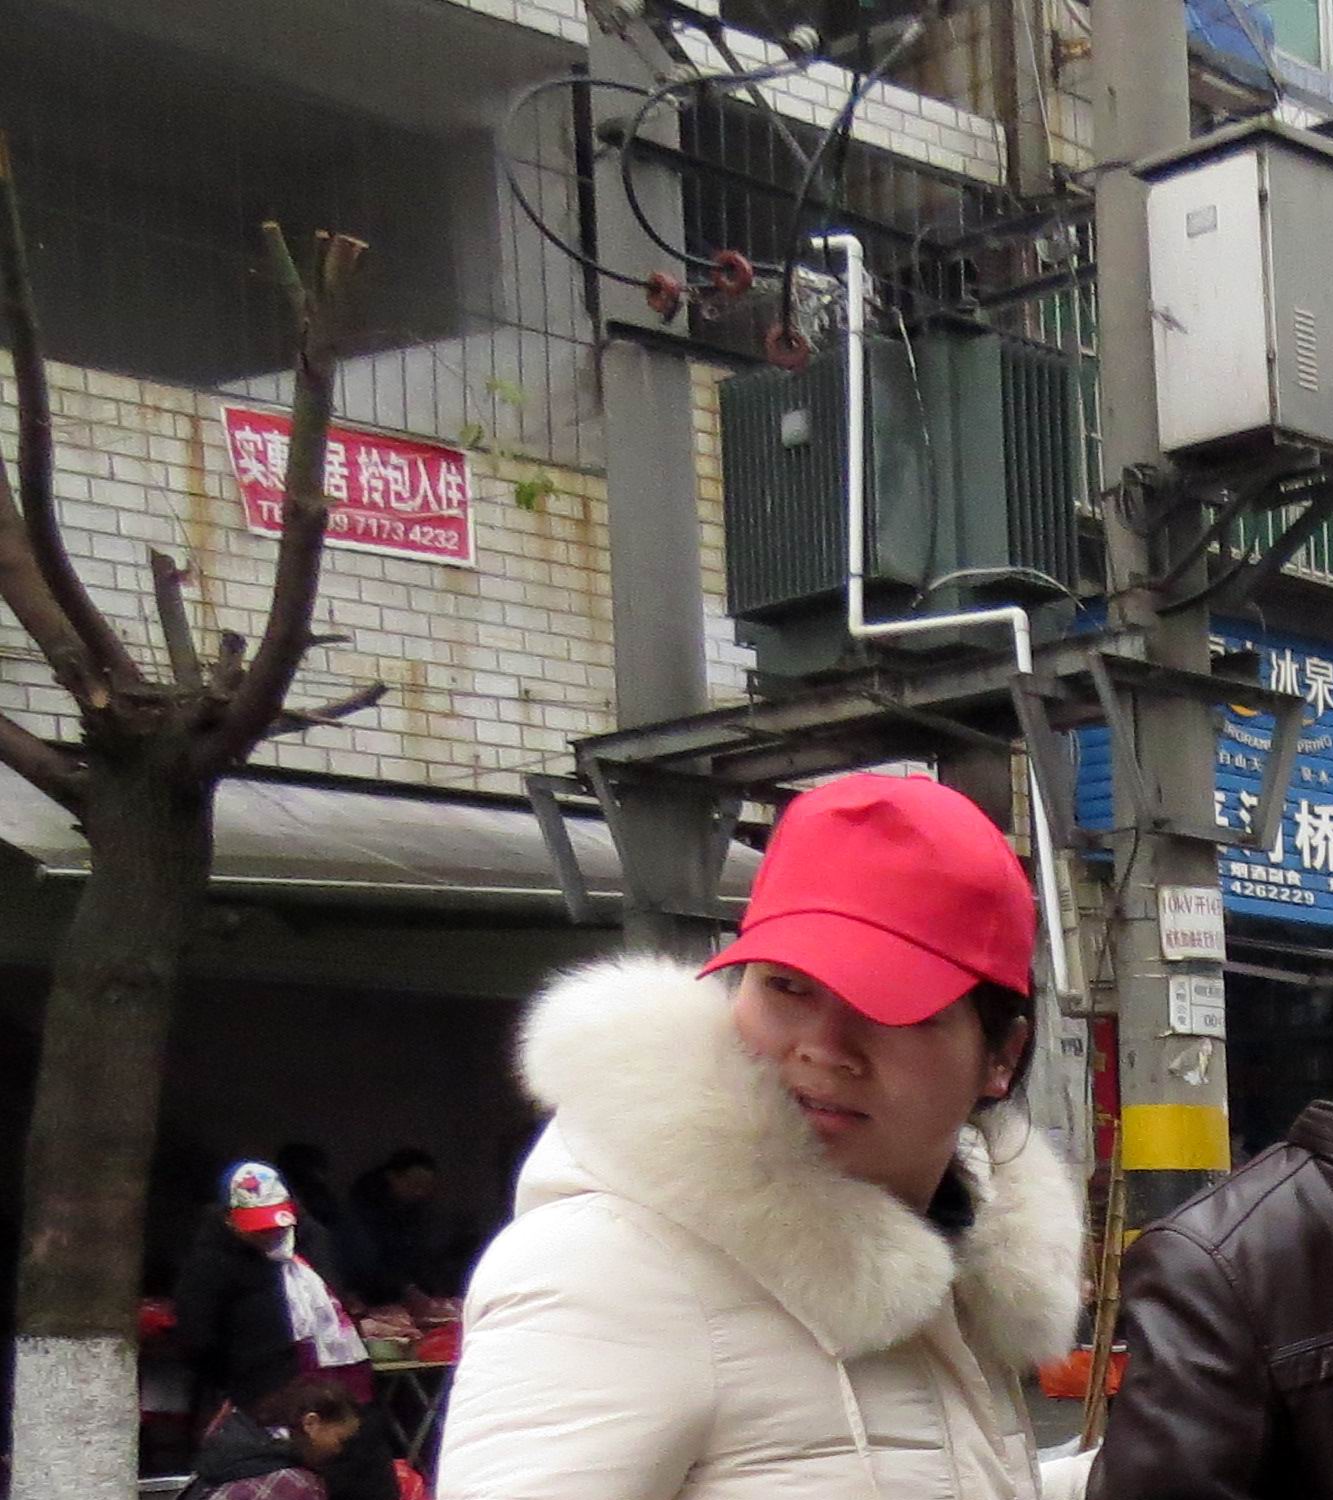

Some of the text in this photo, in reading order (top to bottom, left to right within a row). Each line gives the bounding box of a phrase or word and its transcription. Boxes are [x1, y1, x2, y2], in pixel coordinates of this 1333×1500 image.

[234, 426, 349, 504] 实惠居
[409, 524, 459, 550] 4232
[1230, 880, 1315, 906] 4262229
